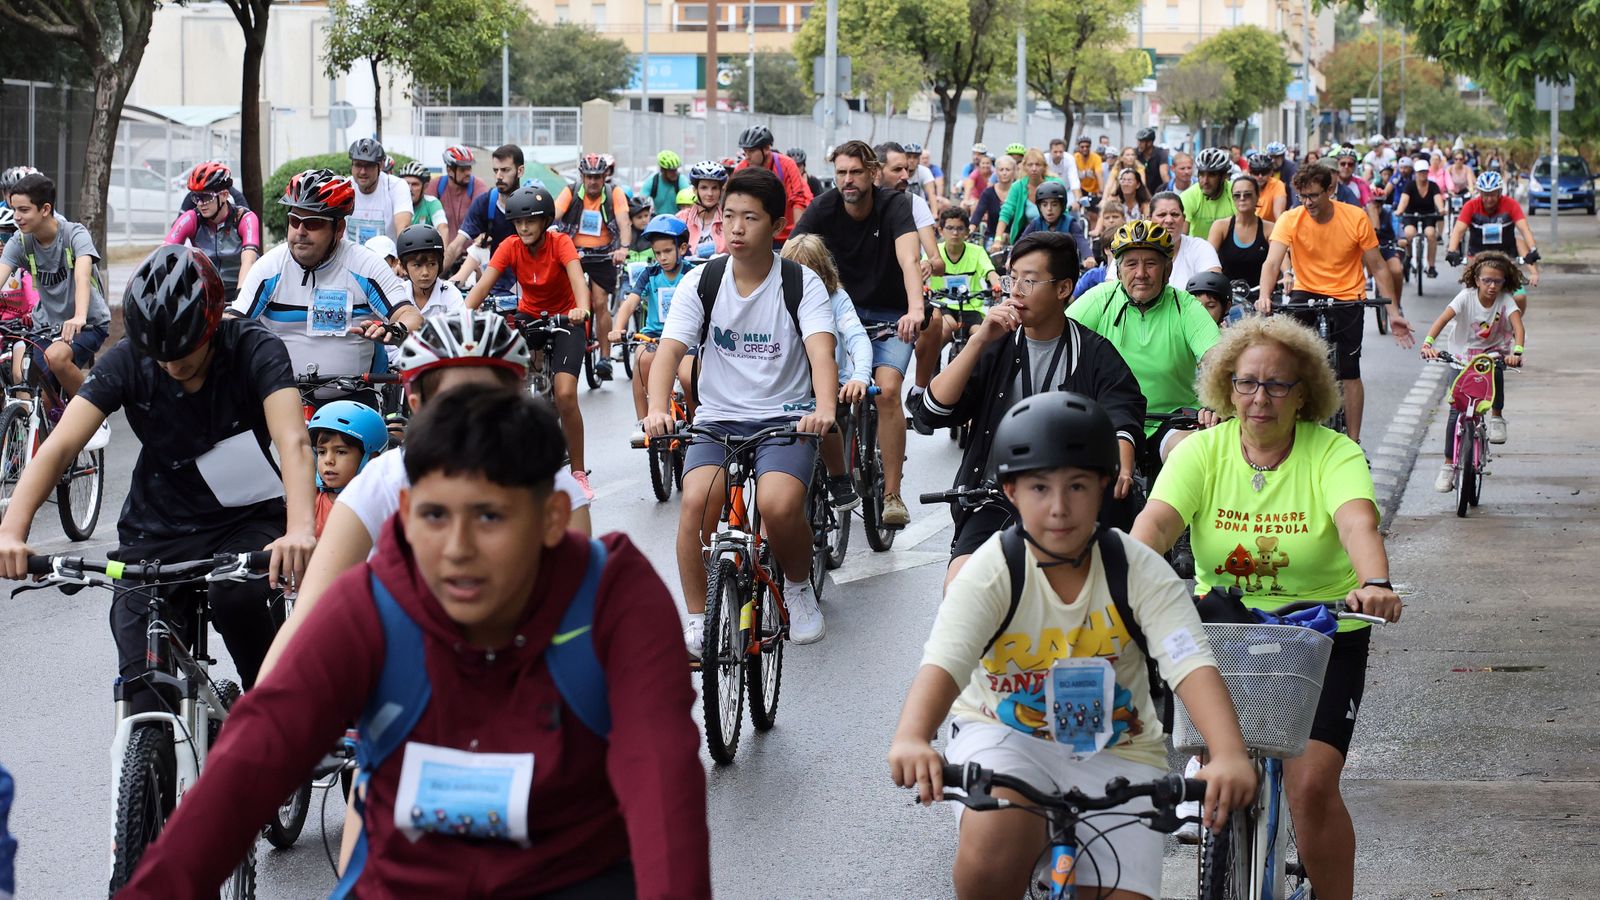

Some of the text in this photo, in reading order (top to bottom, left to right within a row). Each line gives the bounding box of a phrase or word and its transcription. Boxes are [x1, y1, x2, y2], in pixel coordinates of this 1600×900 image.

[743, 342, 781, 354] CREAOR
[1217, 508, 1306, 523] DONA SANGRE
[1215, 519, 1308, 534] DONA MEDULA
